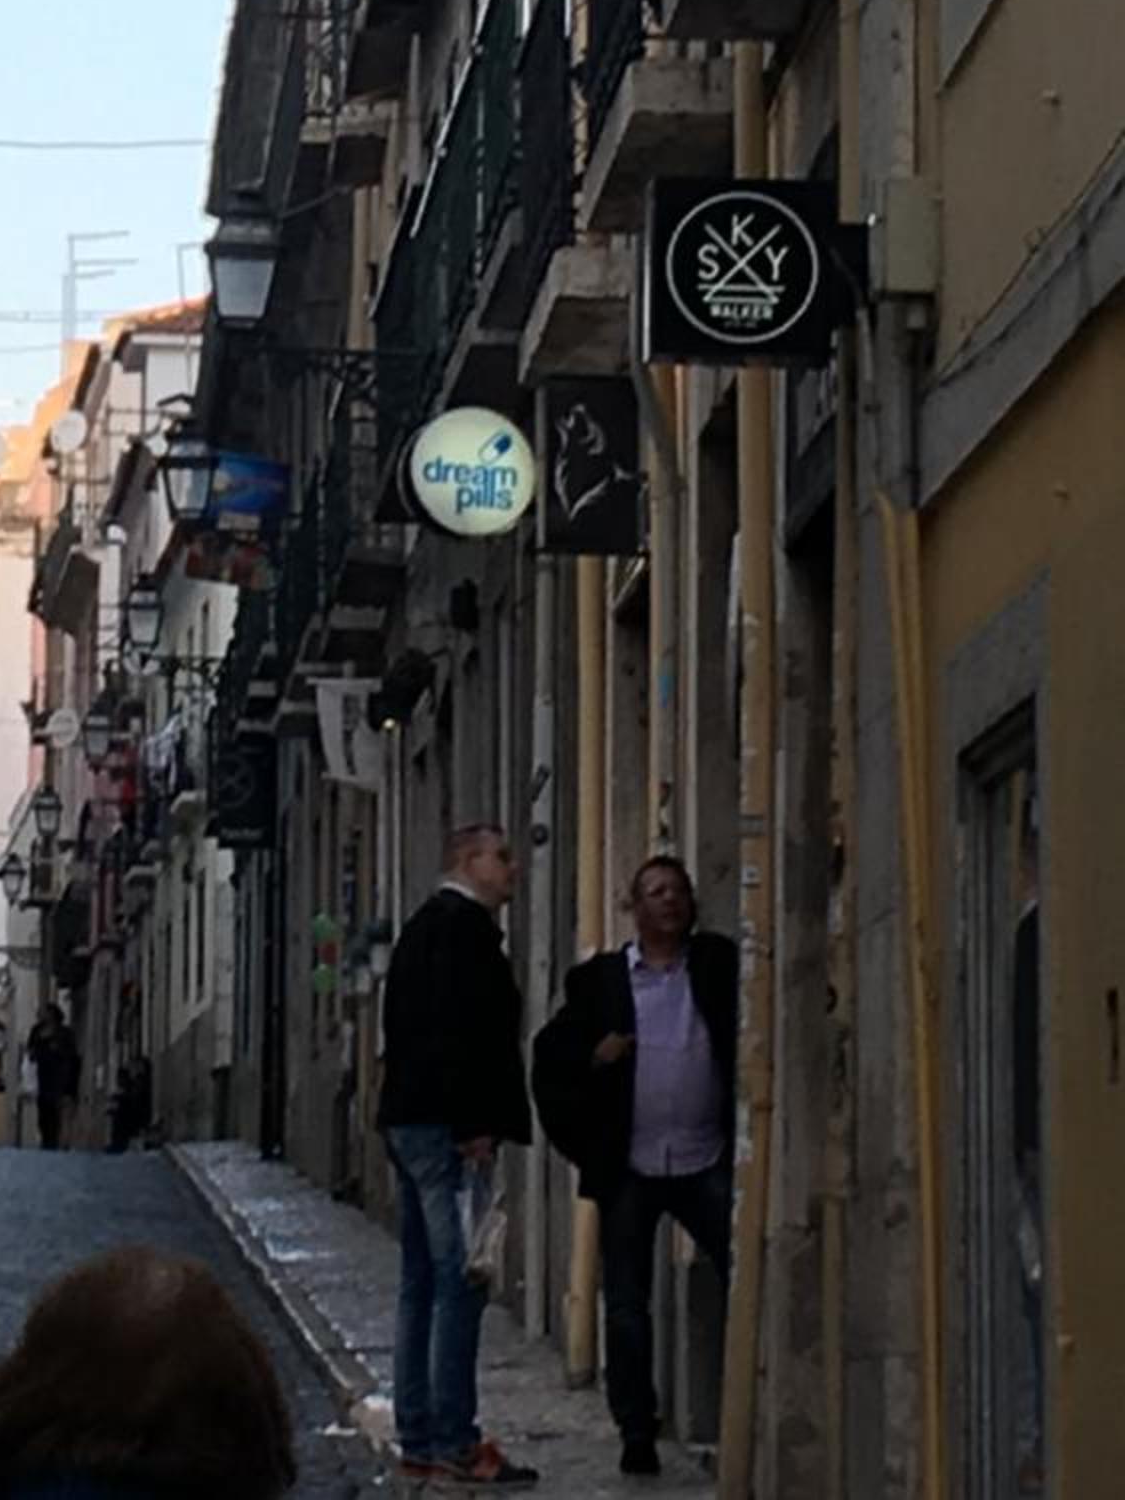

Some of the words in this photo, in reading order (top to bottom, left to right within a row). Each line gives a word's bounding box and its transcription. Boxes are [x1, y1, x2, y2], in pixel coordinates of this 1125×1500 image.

[698, 213, 788, 281] SKY
[709, 304, 774, 320] WALKER
[423, 457, 517, 487] dream
[455, 483, 513, 513] pills
